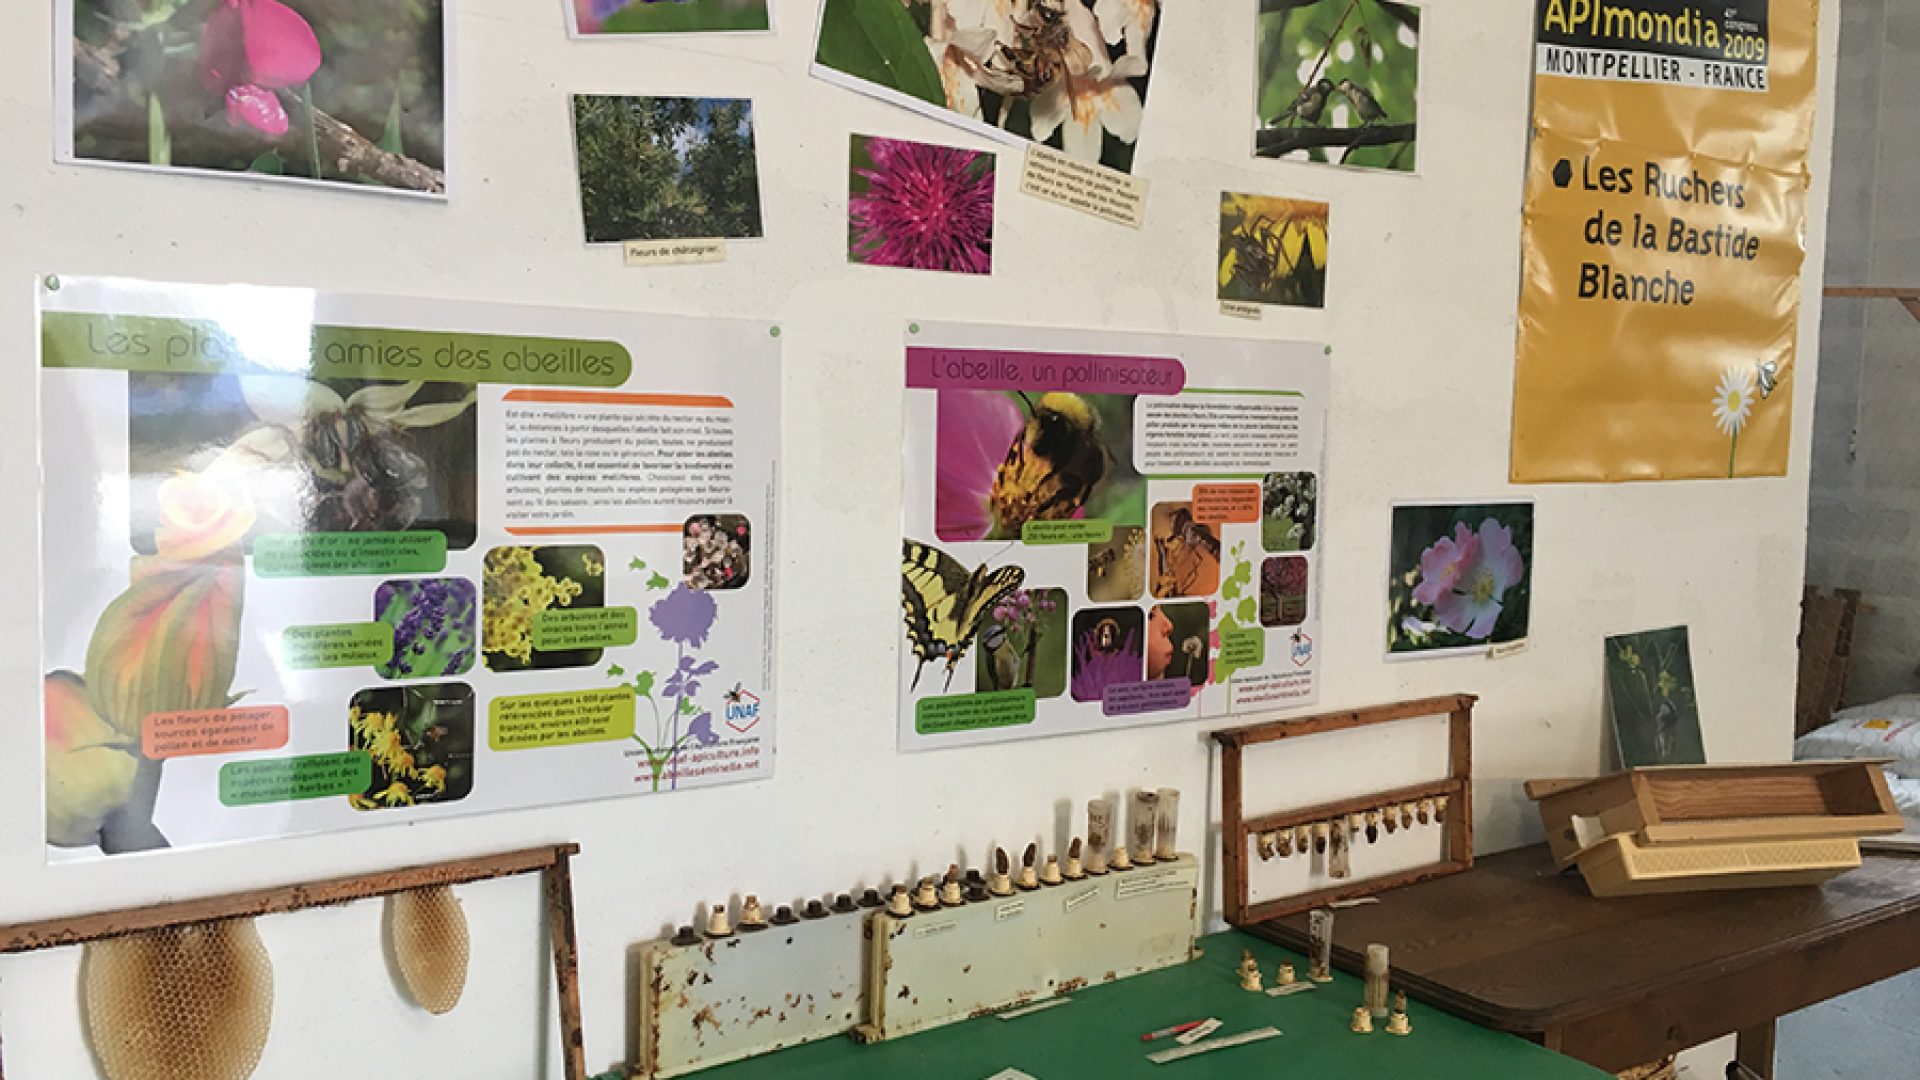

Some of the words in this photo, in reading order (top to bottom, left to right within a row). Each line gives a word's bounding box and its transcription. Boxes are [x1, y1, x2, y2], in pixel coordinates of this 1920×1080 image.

[1724, 33, 1765, 61] 2009
[1546, 48, 1681, 82] MONTPELLIER
[1704, 63, 1765, 90] FRANCE
[1583, 155, 1633, 194] Les
[1645, 162, 1746, 209] Ruchers
[1584, 210, 1622, 246] de
[1633, 213, 1658, 251] la
[1667, 217, 1760, 261] Bastide
[1579, 262, 1695, 306] Blanche
[88, 321, 150, 356] Les
[324, 339, 423, 368] amies
[434, 341, 491, 370] des
[502, 344, 615, 376] abeilles
[931, 354, 1025, 383] L'abeille,
[1032, 364, 1057, 382] un
[1062, 362, 1174, 388] pollinisateur
[726, 703, 759, 720] UNAF
